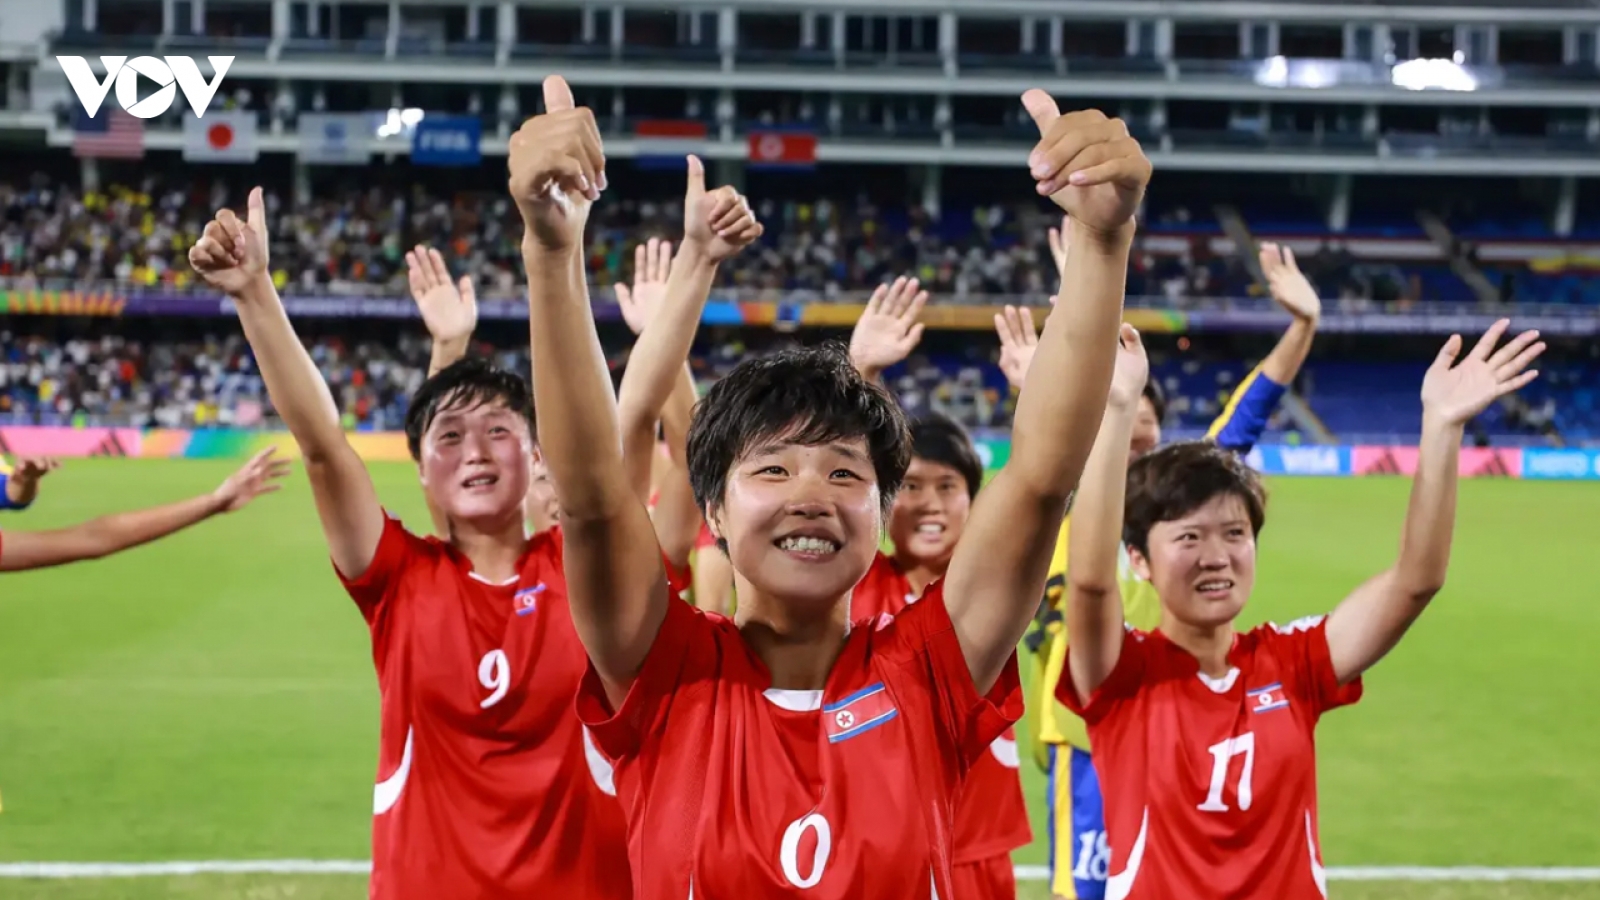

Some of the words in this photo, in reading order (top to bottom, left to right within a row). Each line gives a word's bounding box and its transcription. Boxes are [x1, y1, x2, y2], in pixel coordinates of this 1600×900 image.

[478, 650, 510, 707] 9
[1197, 731, 1254, 811] 17
[1073, 830, 1112, 880] 18
